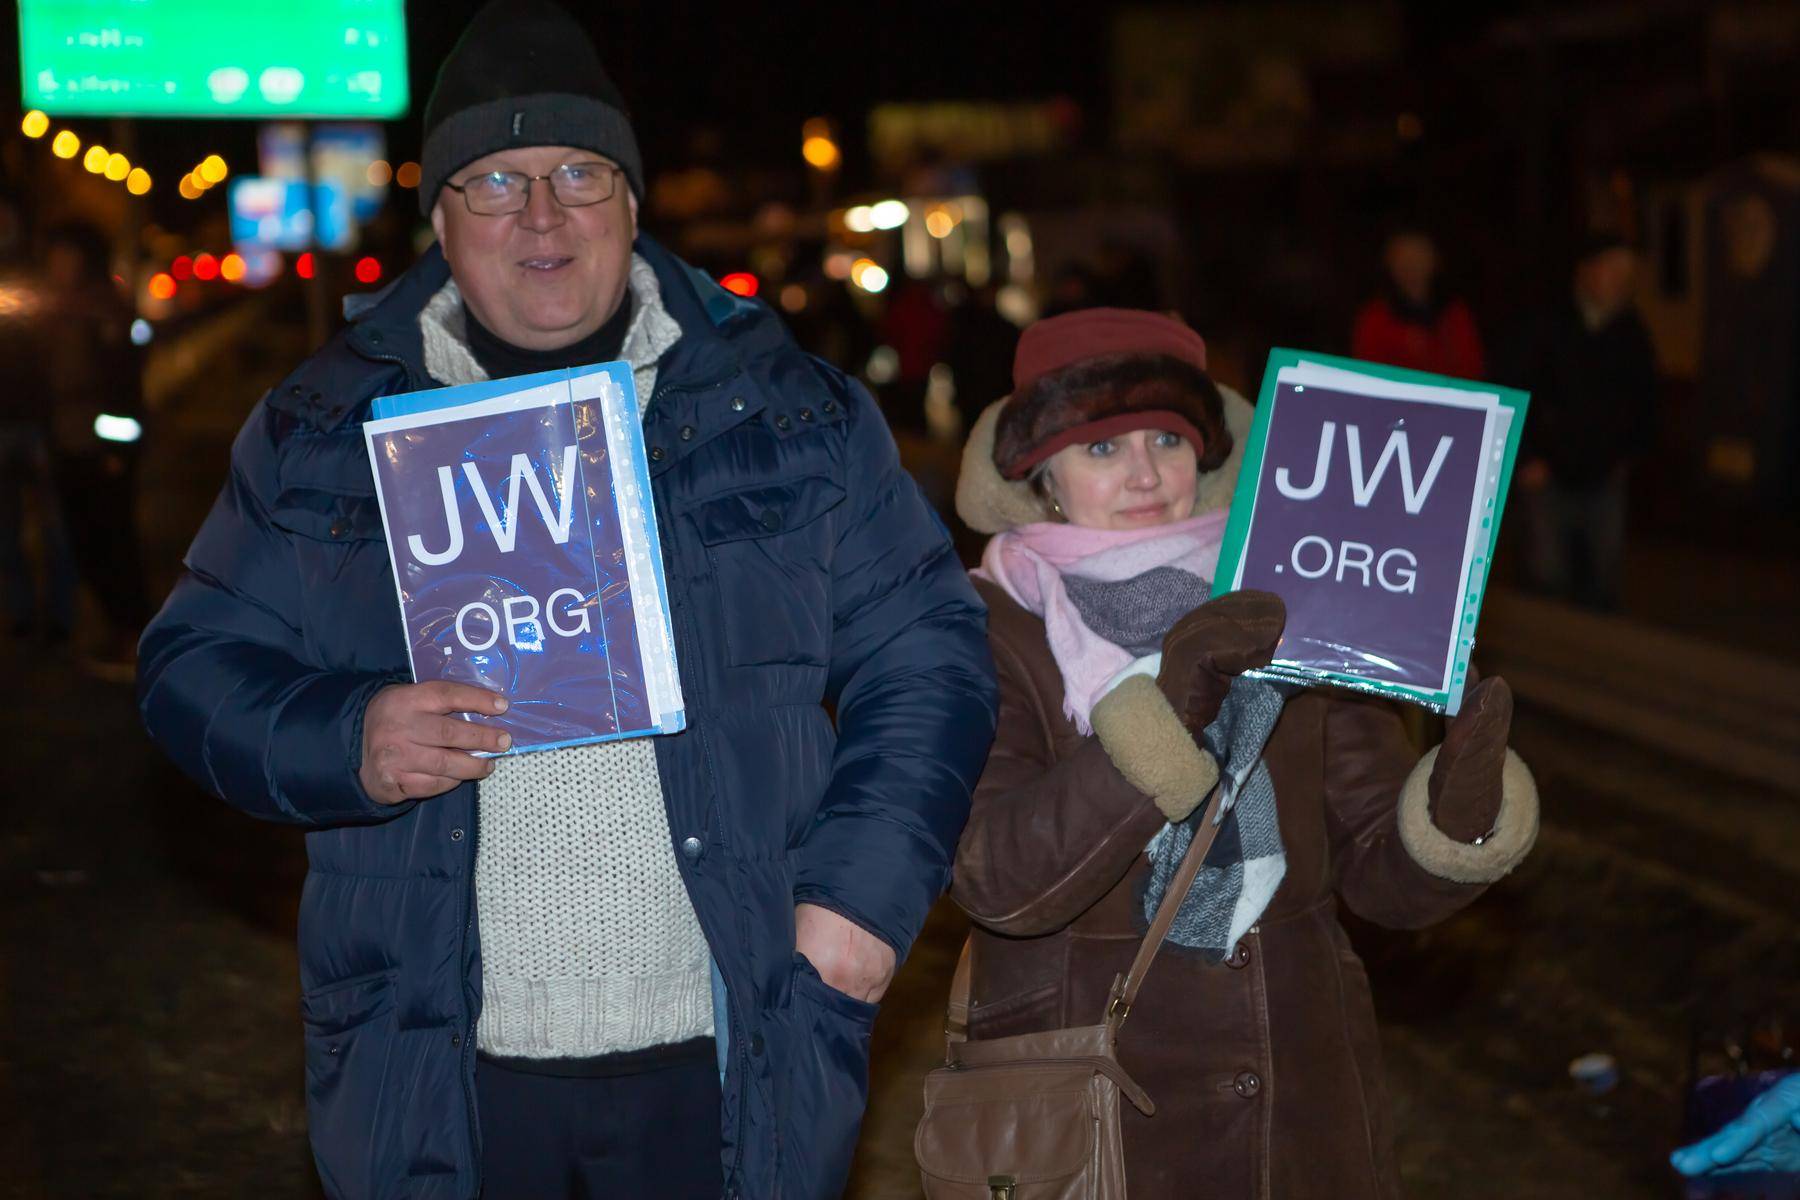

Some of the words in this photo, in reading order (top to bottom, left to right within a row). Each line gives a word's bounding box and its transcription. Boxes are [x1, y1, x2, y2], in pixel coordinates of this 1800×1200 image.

[407, 445, 577, 566] JW
[1275, 421, 1454, 515] JW
[1275, 535, 1418, 594] .ORG
[443, 588, 591, 655] .ORG
